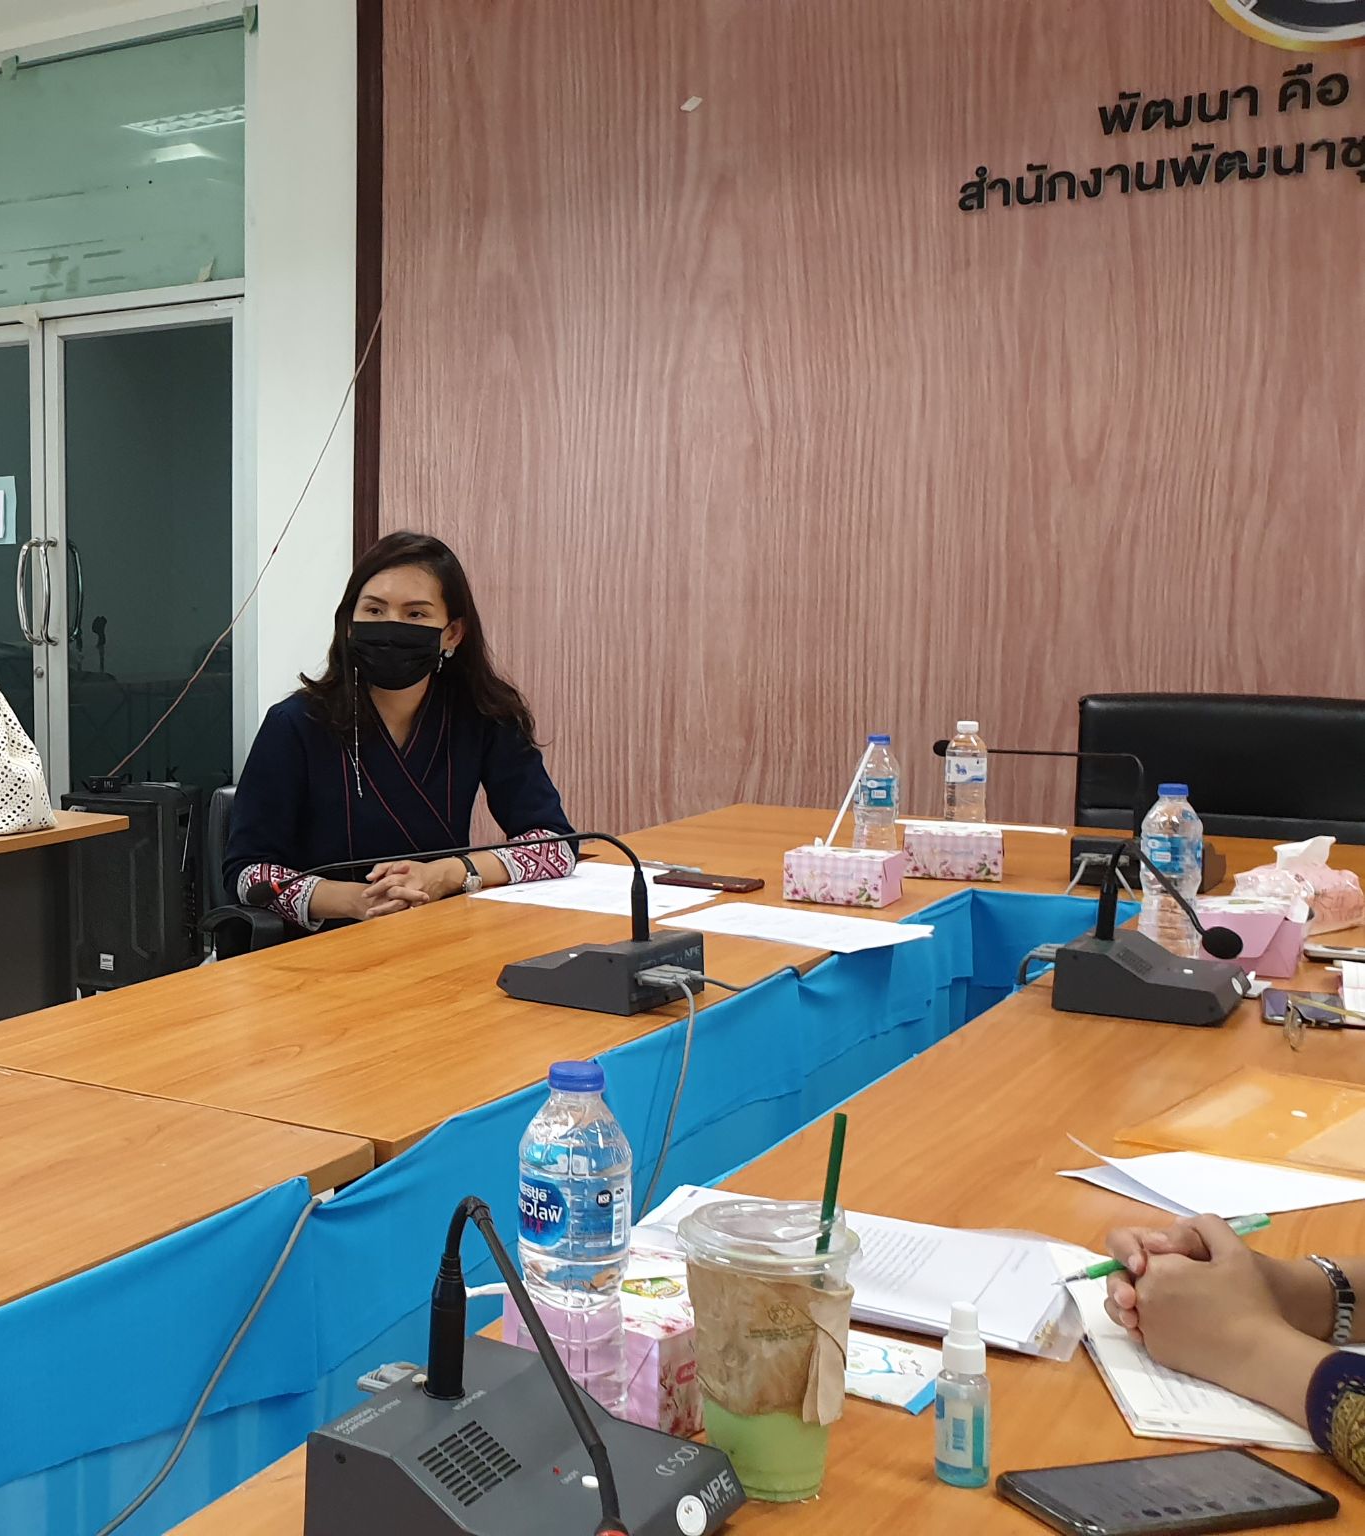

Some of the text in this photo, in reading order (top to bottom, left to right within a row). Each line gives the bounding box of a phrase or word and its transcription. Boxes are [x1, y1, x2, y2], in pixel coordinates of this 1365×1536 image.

[1098, 62, 1350, 136] พัฒนา คือ
[699, 1469, 734, 1507] NPE
